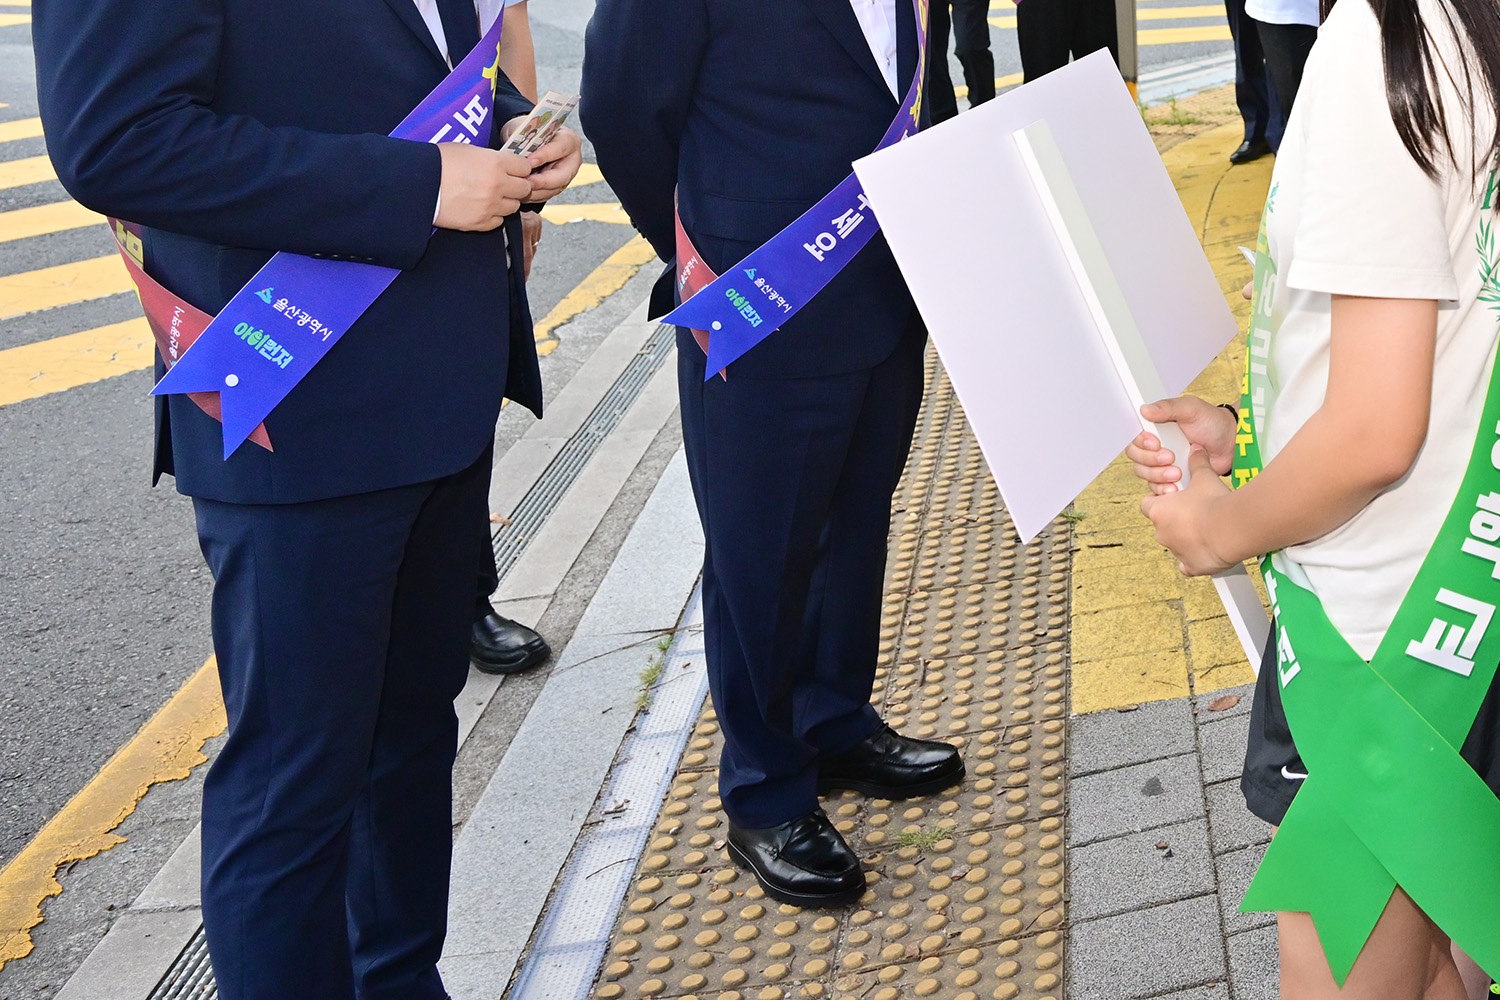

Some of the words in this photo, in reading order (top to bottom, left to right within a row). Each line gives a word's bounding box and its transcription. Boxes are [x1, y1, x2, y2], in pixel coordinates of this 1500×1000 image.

[725, 287, 764, 328] 아이먼저
[753, 277, 793, 314] 울산광역시
[168, 305, 185, 360] 울산광역시
[273, 297, 333, 342] 울산광역시
[233, 321, 295, 370] 아이먼저
